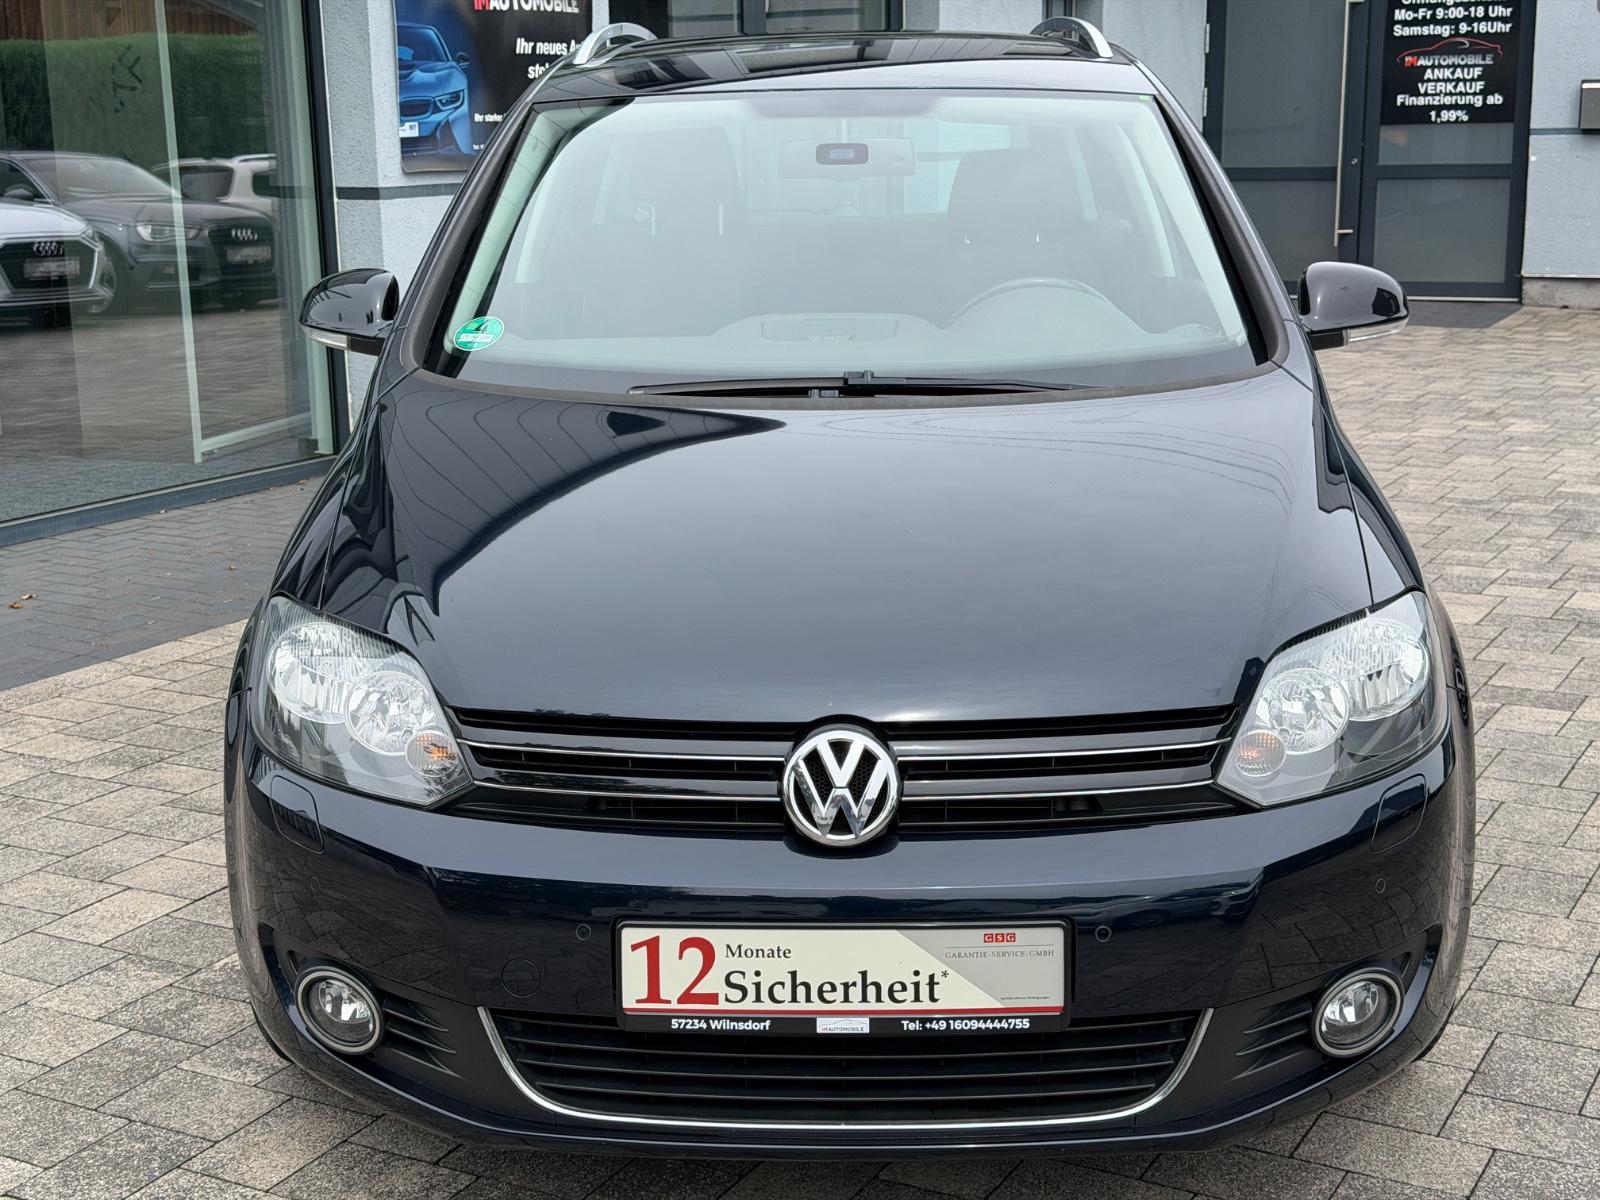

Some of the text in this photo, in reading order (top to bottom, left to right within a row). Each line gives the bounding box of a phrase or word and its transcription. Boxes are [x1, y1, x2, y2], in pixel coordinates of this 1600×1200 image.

[1394, 5, 1513, 20] Mo-Fr 9:00-18 Uhr
[1393, 21, 1513, 37] Samstag: 9-16Uhr
[515, 37, 534, 54] Ihr
[535, 42, 568, 56] neues
[1423, 67, 1483, 80] ANKAUF
[1417, 81, 1485, 94] VERKAUF
[1396, 93, 1504, 107] Finanzierung ab
[1429, 110, 1469, 123] 1,99%
[983, 932, 1017, 943] GSG
[630, 935, 792, 1006] 12 Monate
[671, 1019, 771, 1031] 57234 Wilnsdorf
[901, 1018, 1030, 1031] Tel: +49 16094444755
